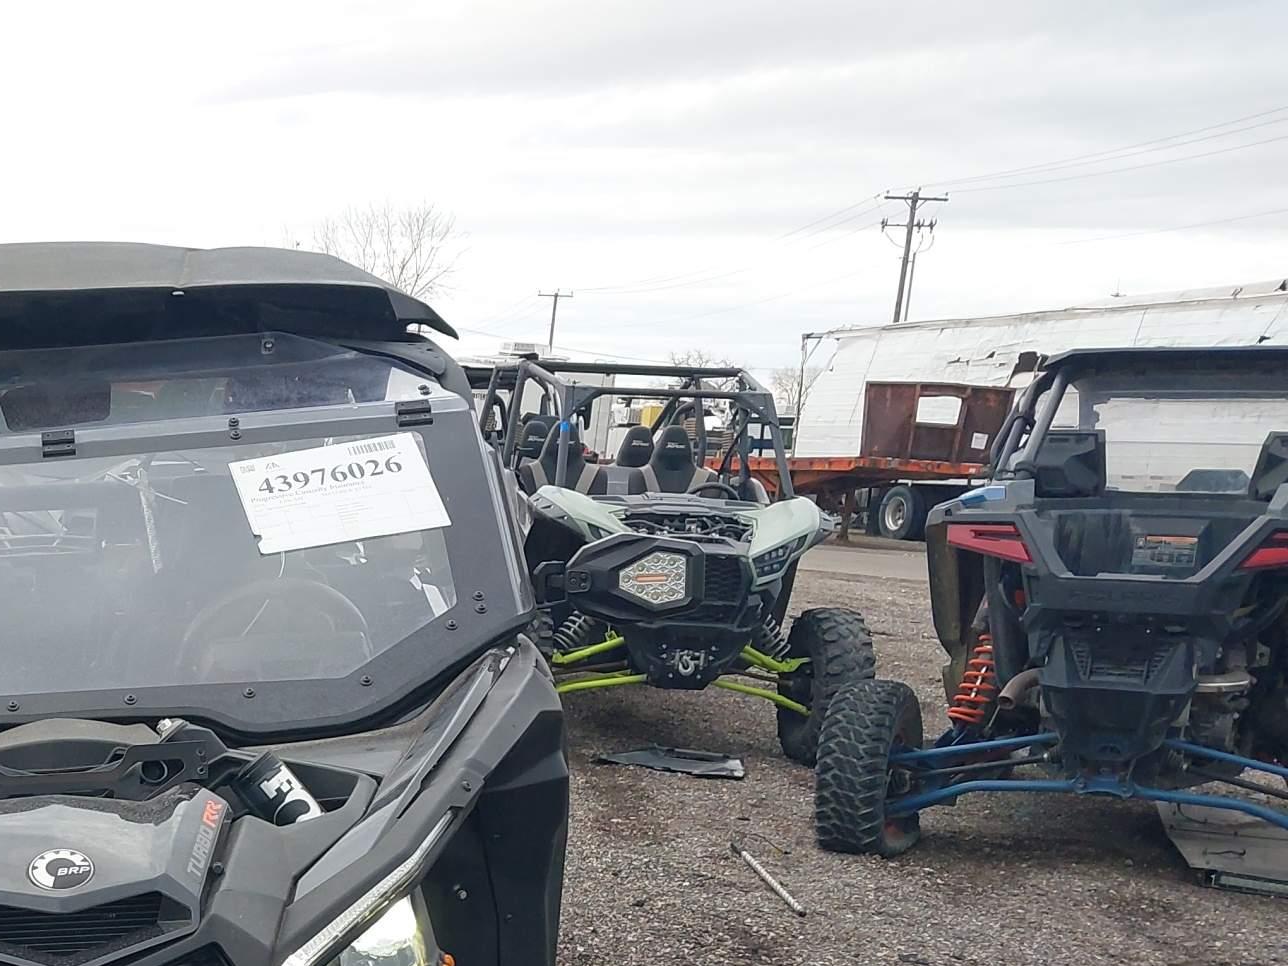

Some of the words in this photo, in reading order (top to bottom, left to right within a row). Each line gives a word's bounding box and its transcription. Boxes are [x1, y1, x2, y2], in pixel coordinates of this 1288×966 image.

[257, 455, 403, 495] 43976026
[56, 865, 91, 877] BRP
[187, 826, 212, 878] TURBO
